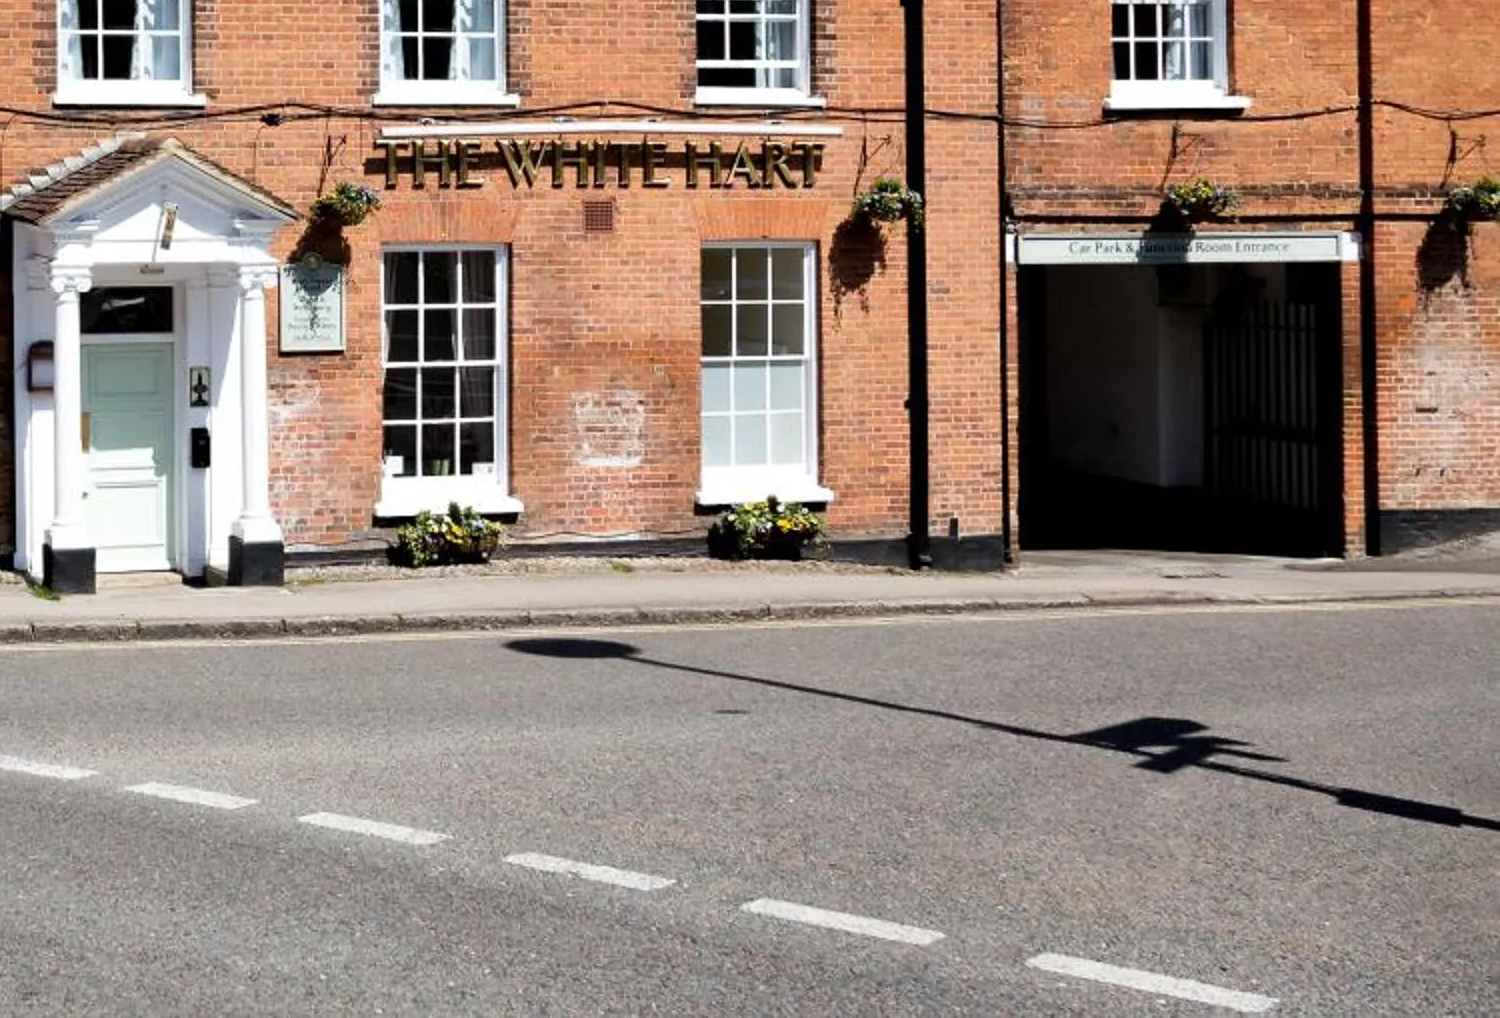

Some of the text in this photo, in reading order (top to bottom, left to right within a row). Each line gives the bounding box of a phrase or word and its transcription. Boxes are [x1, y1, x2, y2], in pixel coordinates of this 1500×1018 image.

[374, 137, 826, 190] THE WHITE HART
[1069, 242, 1091, 253] Car
[1095, 241, 1122, 254] Park
[1125, 241, 1135, 253] &
[1195, 241, 1232, 253] Room
[1235, 241, 1290, 253] Entrance
